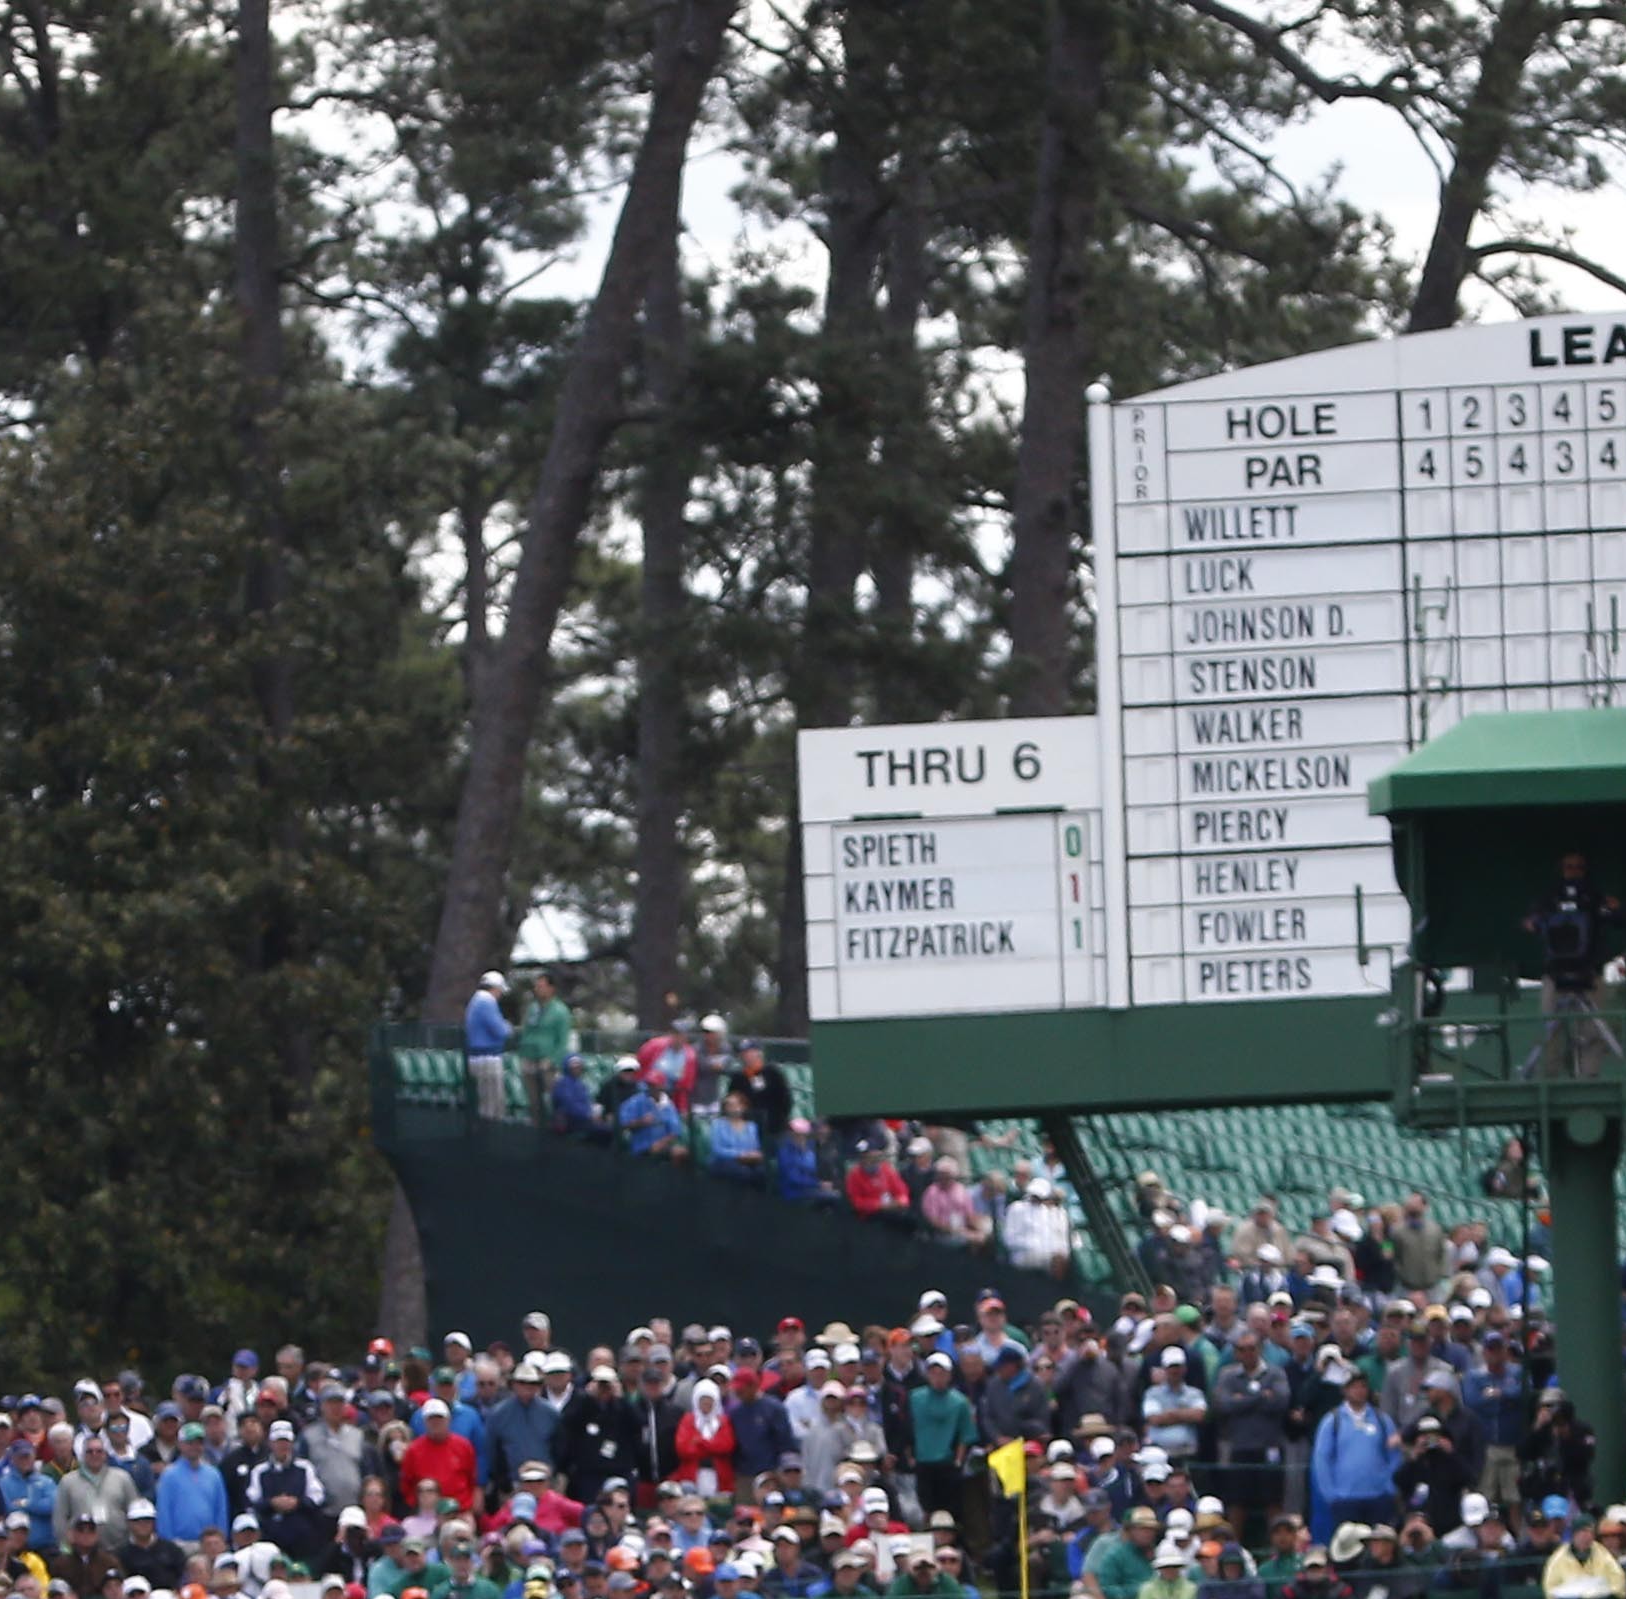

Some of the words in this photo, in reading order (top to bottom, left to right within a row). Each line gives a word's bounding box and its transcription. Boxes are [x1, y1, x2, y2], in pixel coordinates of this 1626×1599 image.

[1226, 403, 1337, 439] HOLE
[1419, 397, 1431, 431] 1
[1463, 395, 1480, 428] 2
[1508, 392, 1526, 426] 3
[1553, 391, 1571, 424] 4
[1598, 389, 1615, 421] 5
[1131, 408, 1149, 499] PRIOR
[1246, 454, 1322, 488] PAR
[1419, 447, 1435, 479] 4
[1465, 446, 1483, 478] 5
[1509, 442, 1526, 476] 4
[1555, 440, 1573, 473] 3
[1599, 438, 1617, 470] 4
[1184, 505, 1298, 541] WILLETT
[1185, 558, 1254, 594] LUCK
[1187, 606, 1313, 644] JOHNSON
[1328, 604, 1353, 637] D.
[1189, 656, 1316, 693] STENSON
[1193, 707, 1302, 743] WALKER
[856, 746, 986, 787] THRU
[1012, 741, 1041, 780] 6
[1193, 755, 1350, 792] MICKELSON
[1194, 808, 1288, 843] PIERCY
[843, 832, 937, 868] SPIETH
[845, 877, 955, 913] KAYMER
[1070, 873, 1080, 903] 1
[1196, 858, 1299, 894] HENLEY
[846, 920, 1015, 959] FITZPATRICK
[1073, 917, 1082, 949] 1
[1198, 908, 1306, 944] FOWLER
[1200, 957, 1312, 994] PIETERS
